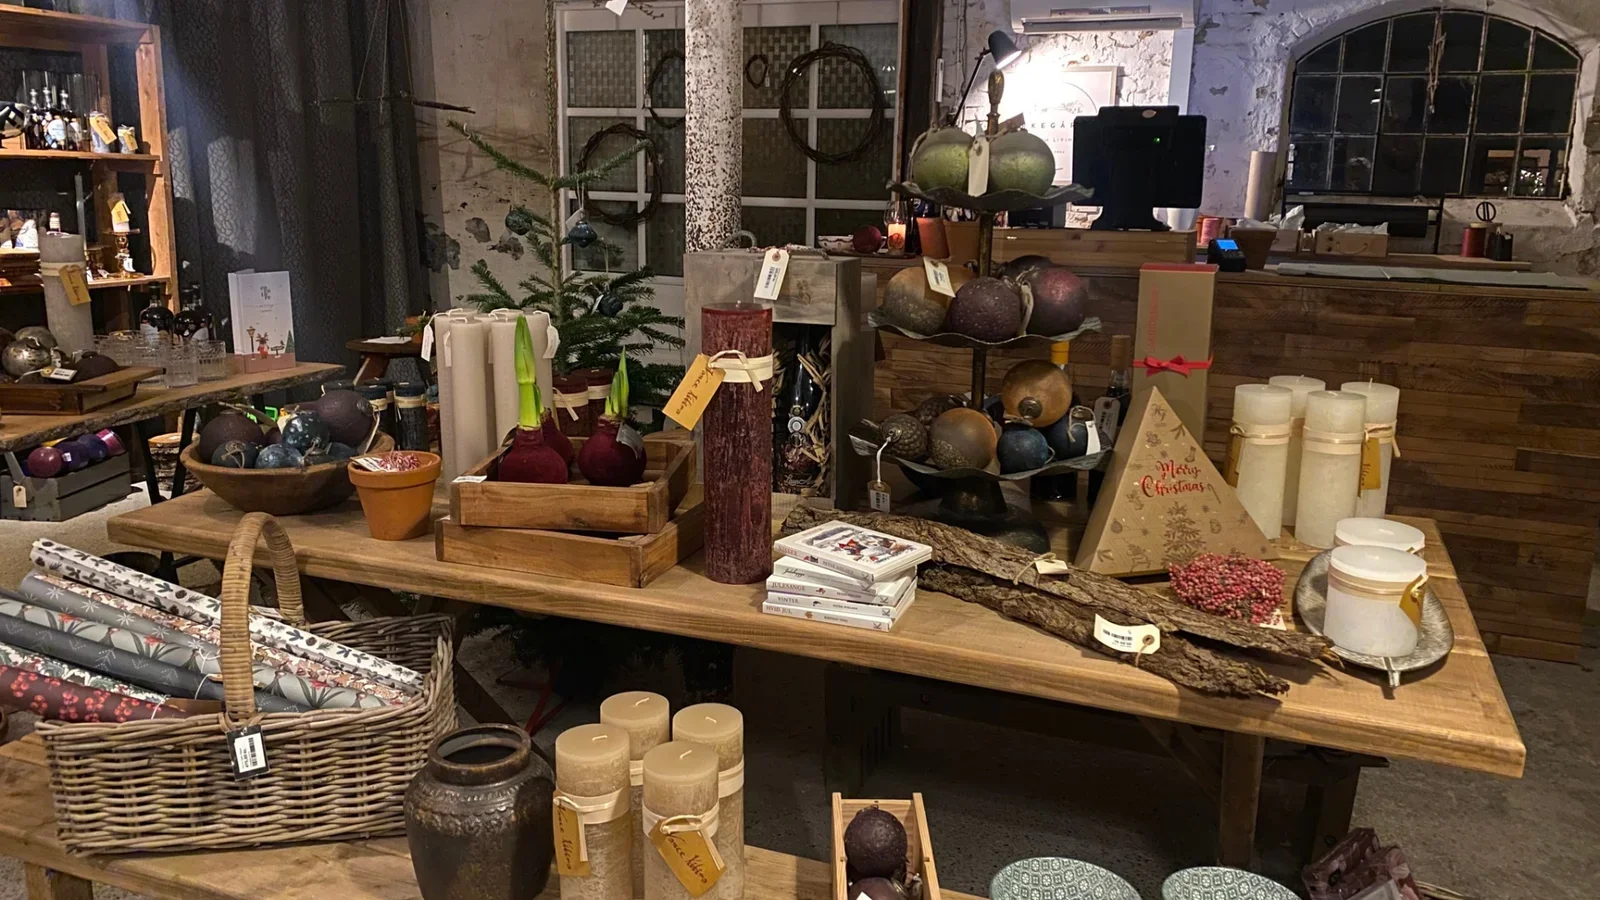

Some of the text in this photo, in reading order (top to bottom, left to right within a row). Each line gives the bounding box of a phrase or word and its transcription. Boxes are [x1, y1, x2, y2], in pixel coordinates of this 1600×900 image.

[1155, 459, 1202, 480] Merry
[1141, 475, 1205, 498] Christmas
[777, 596, 800, 604] VINTER
